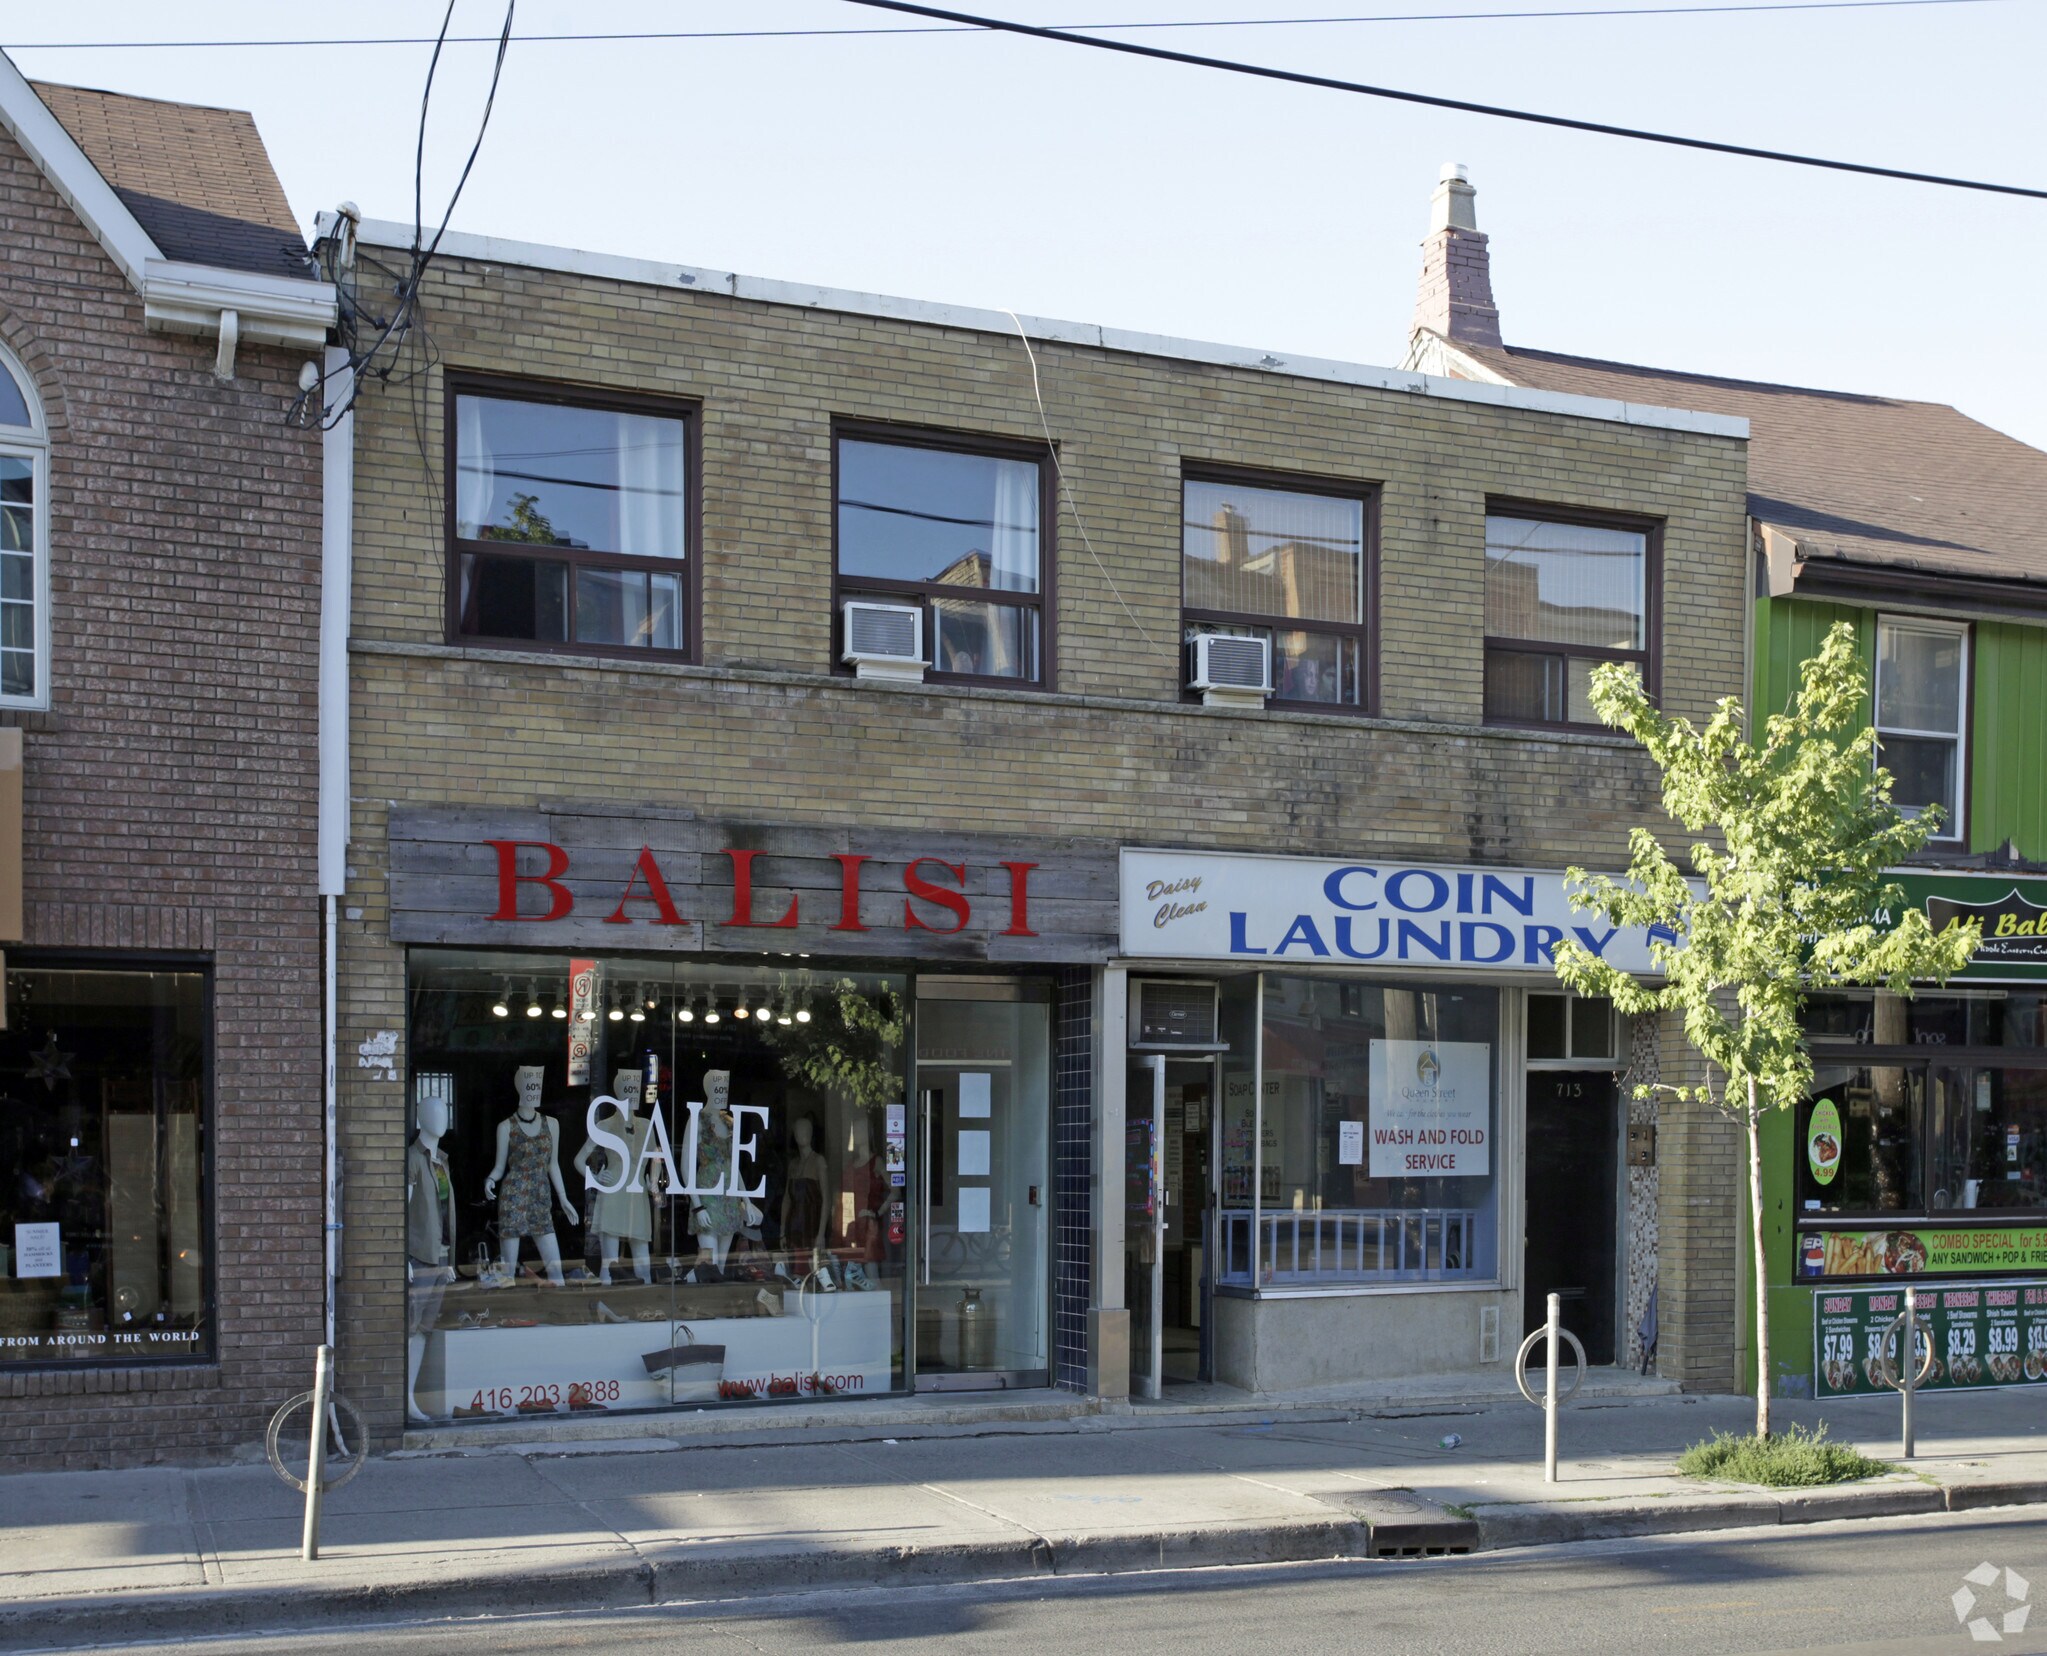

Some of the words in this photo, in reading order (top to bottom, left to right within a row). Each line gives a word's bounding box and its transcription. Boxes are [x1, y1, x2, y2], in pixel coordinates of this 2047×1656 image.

[483, 840, 1040, 936] BALISI
[1146, 877, 1202, 901] Daisy
[1323, 866, 1535, 917] COIN
[1154, 901, 1208, 928] Clean
[1228, 911, 1620, 965] LAUNDRY
[1975, 943, 2000, 953] iddle
[2001, 941, 2033, 954] Eastern
[524, 1071, 534, 1079] UP
[526, 1083, 542, 1091] 60%
[624, 1086, 639, 1094] 60%
[714, 1086, 728, 1094] 60%
[1229, 1081, 1248, 1097] SOAP
[1402, 1086, 1430, 1099] Queen
[1432, 1086, 1457, 1098] Sreet
[1556, 1083, 1582, 1098] 713
[527, 1094, 540, 1102] OFF
[714, 1097, 728, 1105] OFF
[1374, 1129, 1413, 1145] WASH
[1417, 1129, 1447, 1145] AND
[1450, 1129, 1485, 1145] FOLD
[585, 1094, 769, 1198] SALE
[1405, 1154, 1456, 1170] SERVICE
[1815, 1168, 1834, 1177] 4.99
[1932, 1233, 1970, 1249] COMBO
[1973, 1232, 2014, 1249] SPECIAL
[2020, 1232, 2033, 1248] for
[1931, 1252, 1949, 1264] ANY
[1950, 1251, 1994, 1264] SANDWICH
[2002, 1251, 2019, 1263] POP
[2020, 1250, 2027, 1263] &
[1868, 1295, 1898, 1311] MONDAY
[1915, 1293, 1938, 1309] ESDAY
[1943, 1291, 1980, 1308] WEDNESDAY
[1985, 1289, 2018, 1306] THURSDAY
[2025, 1288, 2036, 1304] FRI
[1824, 1296, 1853, 1313] SUNDAY
[1986, 1309, 2000, 1317] Shish
[2000, 1308, 2018, 1317] Tawook
[1874, 1315, 1895, 1323] Chicken
[1946, 1311, 1950, 1319] 2
[1950, 1311, 1959, 1319] Beef
[0, 1336, 39, 1347] FROM
[46, 1334, 107, 1346] AROUND
[113, 1333, 142, 1343] THE
[149, 1331, 200, 1342] WORLD
[1824, 1333, 1853, 1360] $7.99
[1947, 1328, 1976, 1356] $8.29
[1988, 1326, 2018, 1353] $8.99
[717, 1371, 864, 1398] www.balisi.com
[470, 1380, 620, 1411] 416.203.2388
